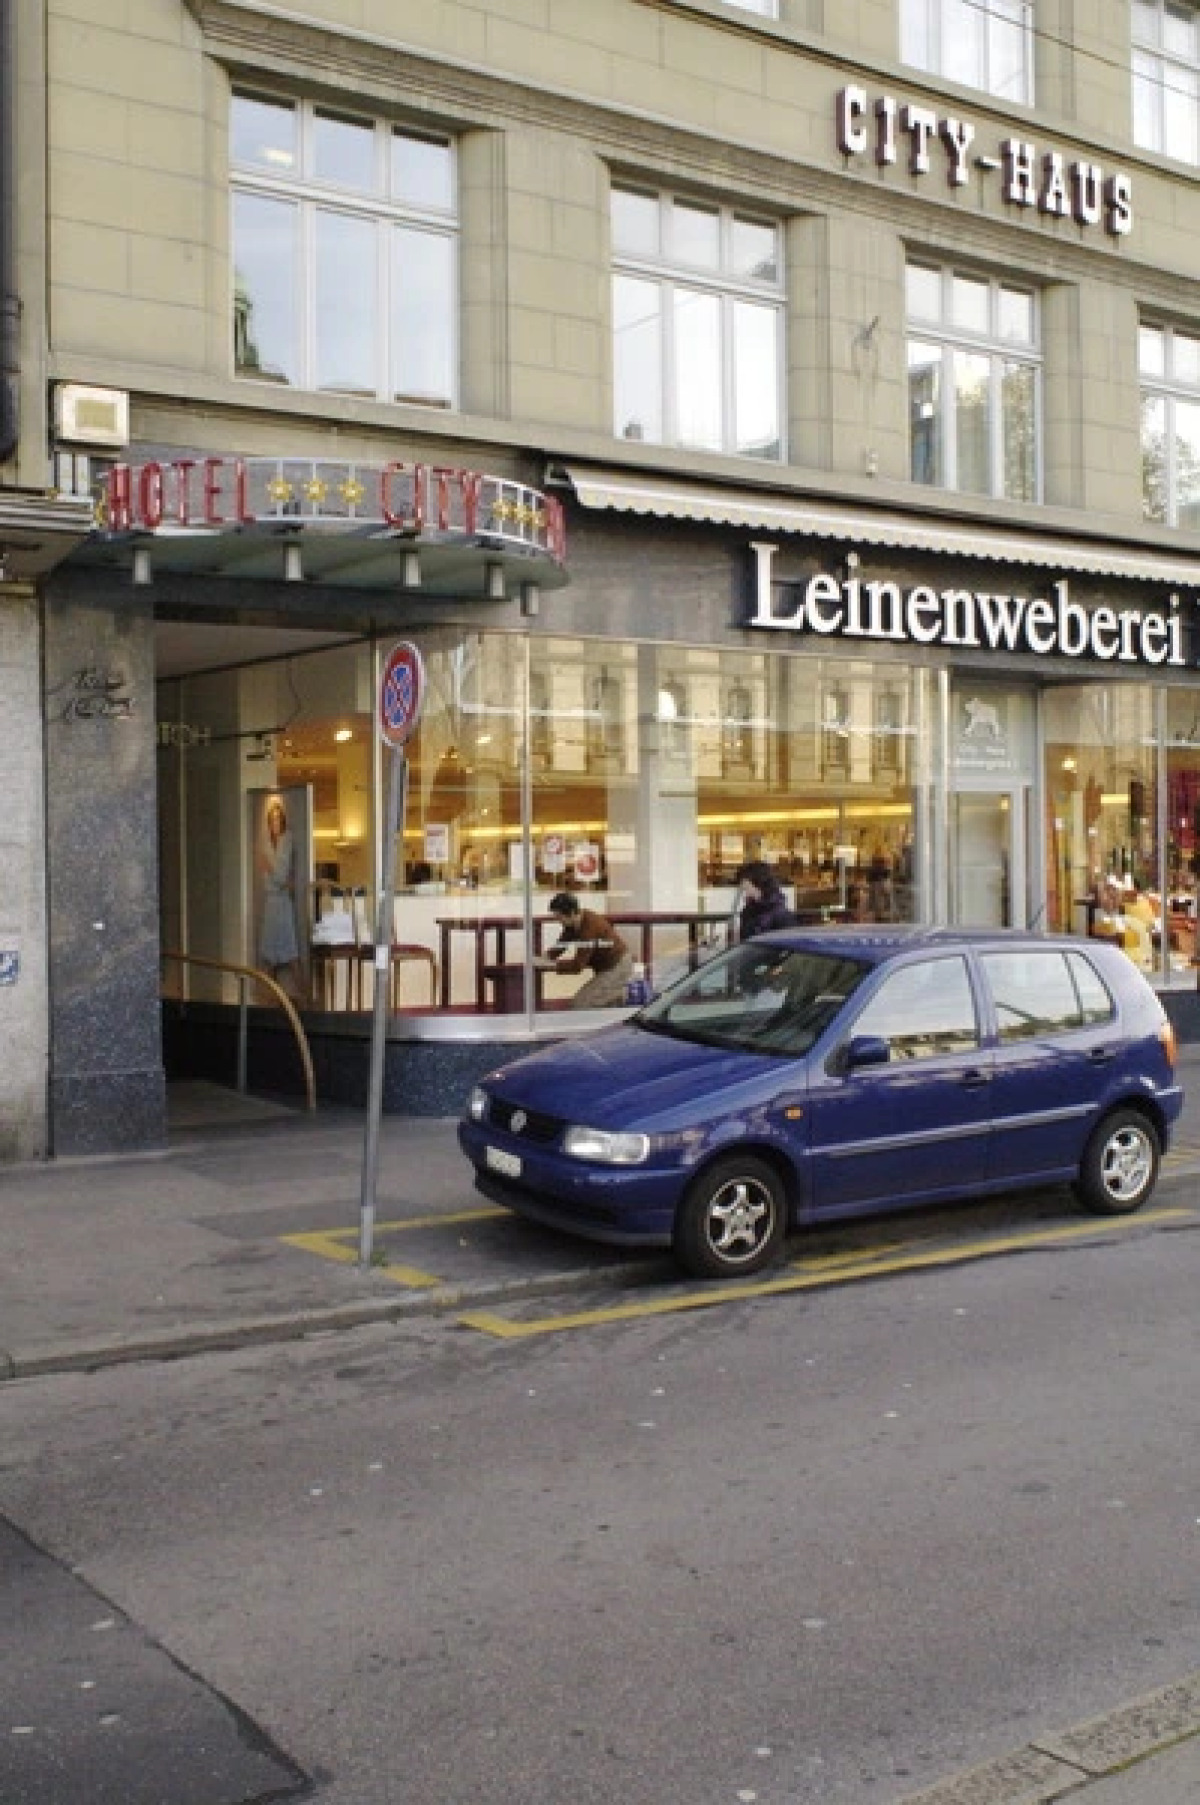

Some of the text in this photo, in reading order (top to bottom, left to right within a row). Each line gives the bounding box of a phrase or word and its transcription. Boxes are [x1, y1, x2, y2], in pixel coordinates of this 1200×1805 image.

[836, 84, 1132, 234] CITY-HAUS
[108, 460, 256, 530] HOTEL
[378, 459, 483, 535] CITY
[749, 541, 1185, 665] Leinenweberei
